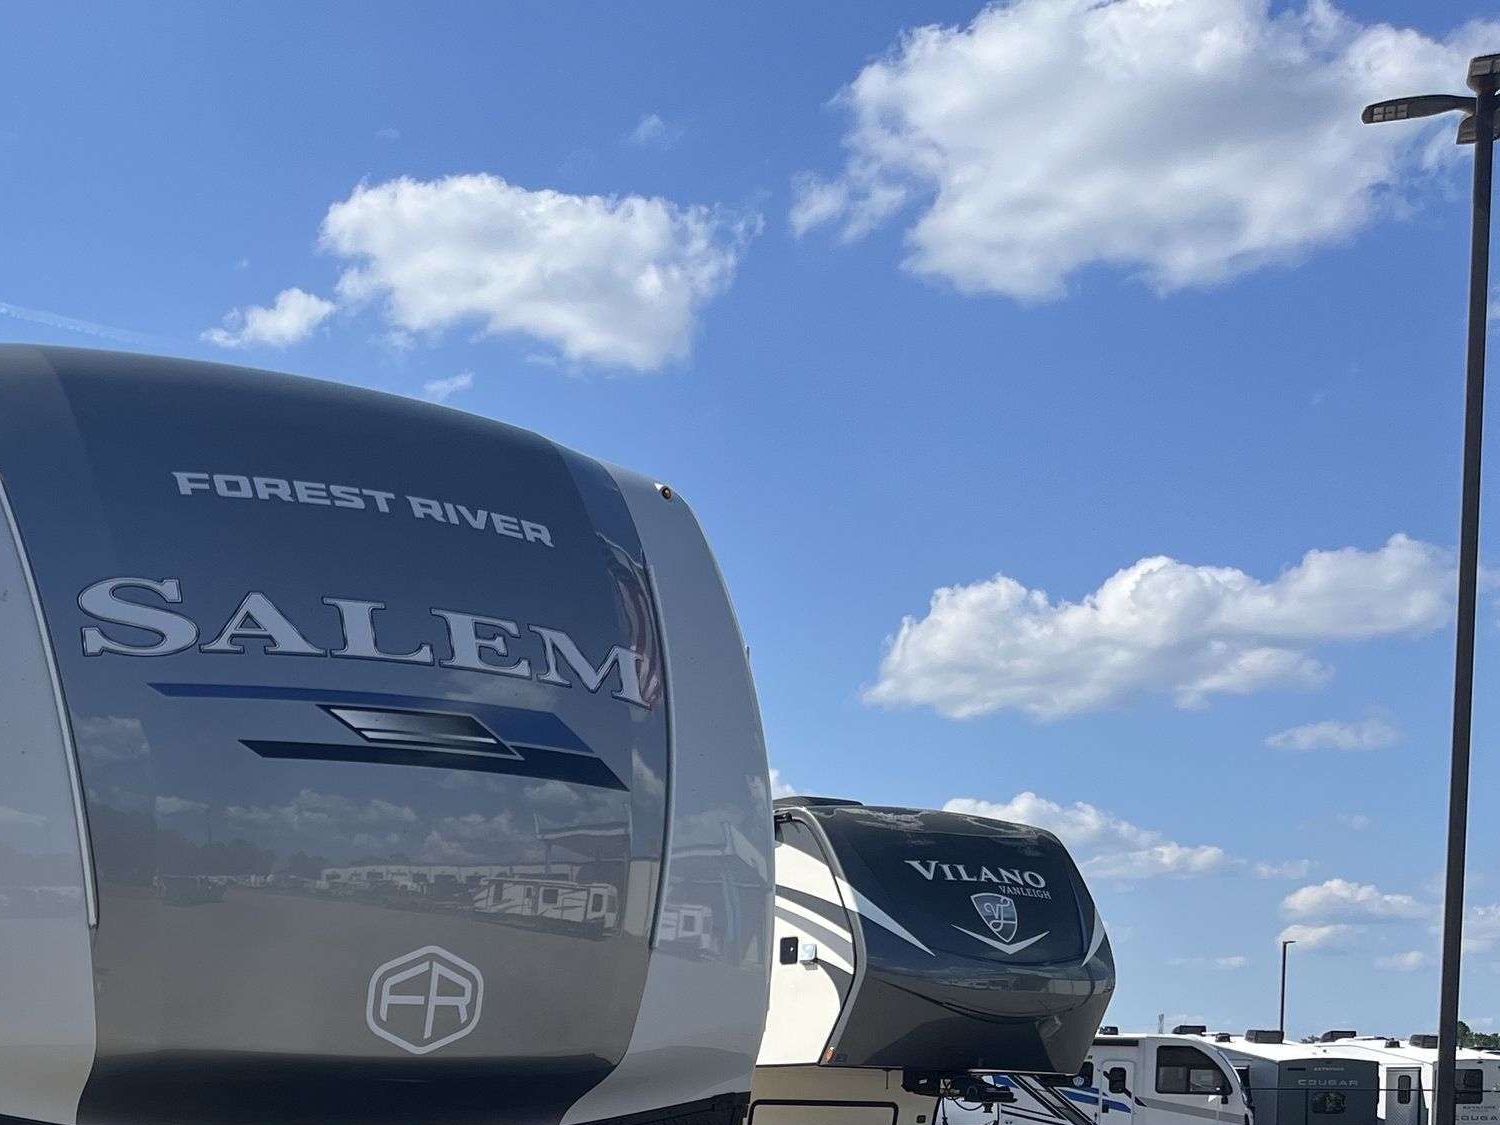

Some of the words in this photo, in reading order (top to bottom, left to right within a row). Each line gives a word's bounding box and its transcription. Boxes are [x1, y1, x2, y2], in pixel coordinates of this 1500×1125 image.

[171, 471, 395, 514] FOREST
[405, 494, 555, 548] RIVER
[77, 576, 654, 711] SALEM
[904, 860, 1046, 888] VILANO
[998, 885, 1052, 900] VANLEIGH
